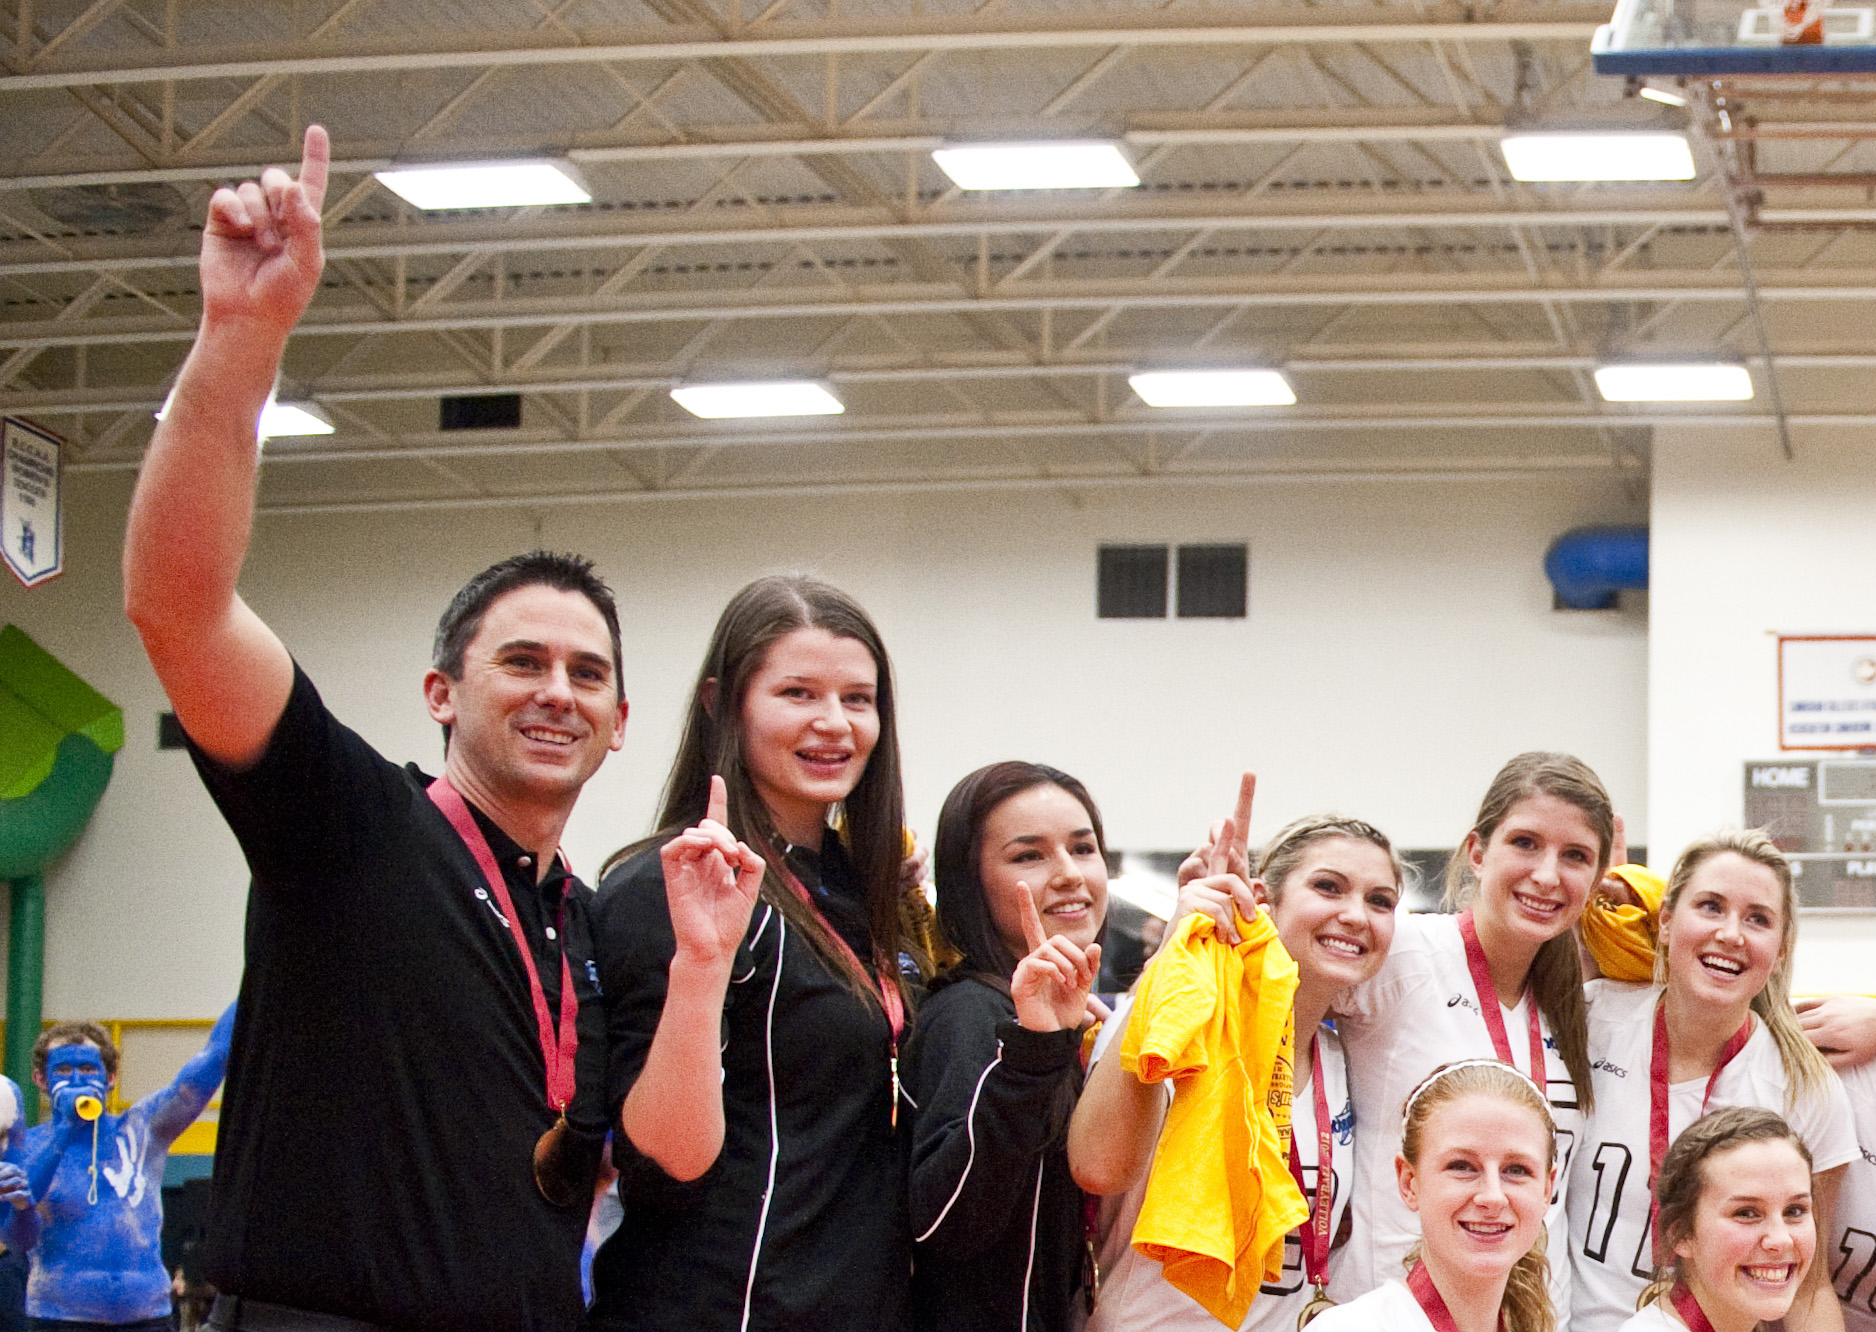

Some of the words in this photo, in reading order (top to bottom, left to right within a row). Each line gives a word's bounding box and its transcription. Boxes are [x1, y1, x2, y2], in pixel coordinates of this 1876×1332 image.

[1752, 767, 1809, 786] HOME
[1603, 1061, 1629, 1079] asics
[1317, 1164, 1331, 1236] VOLLEYBALL
